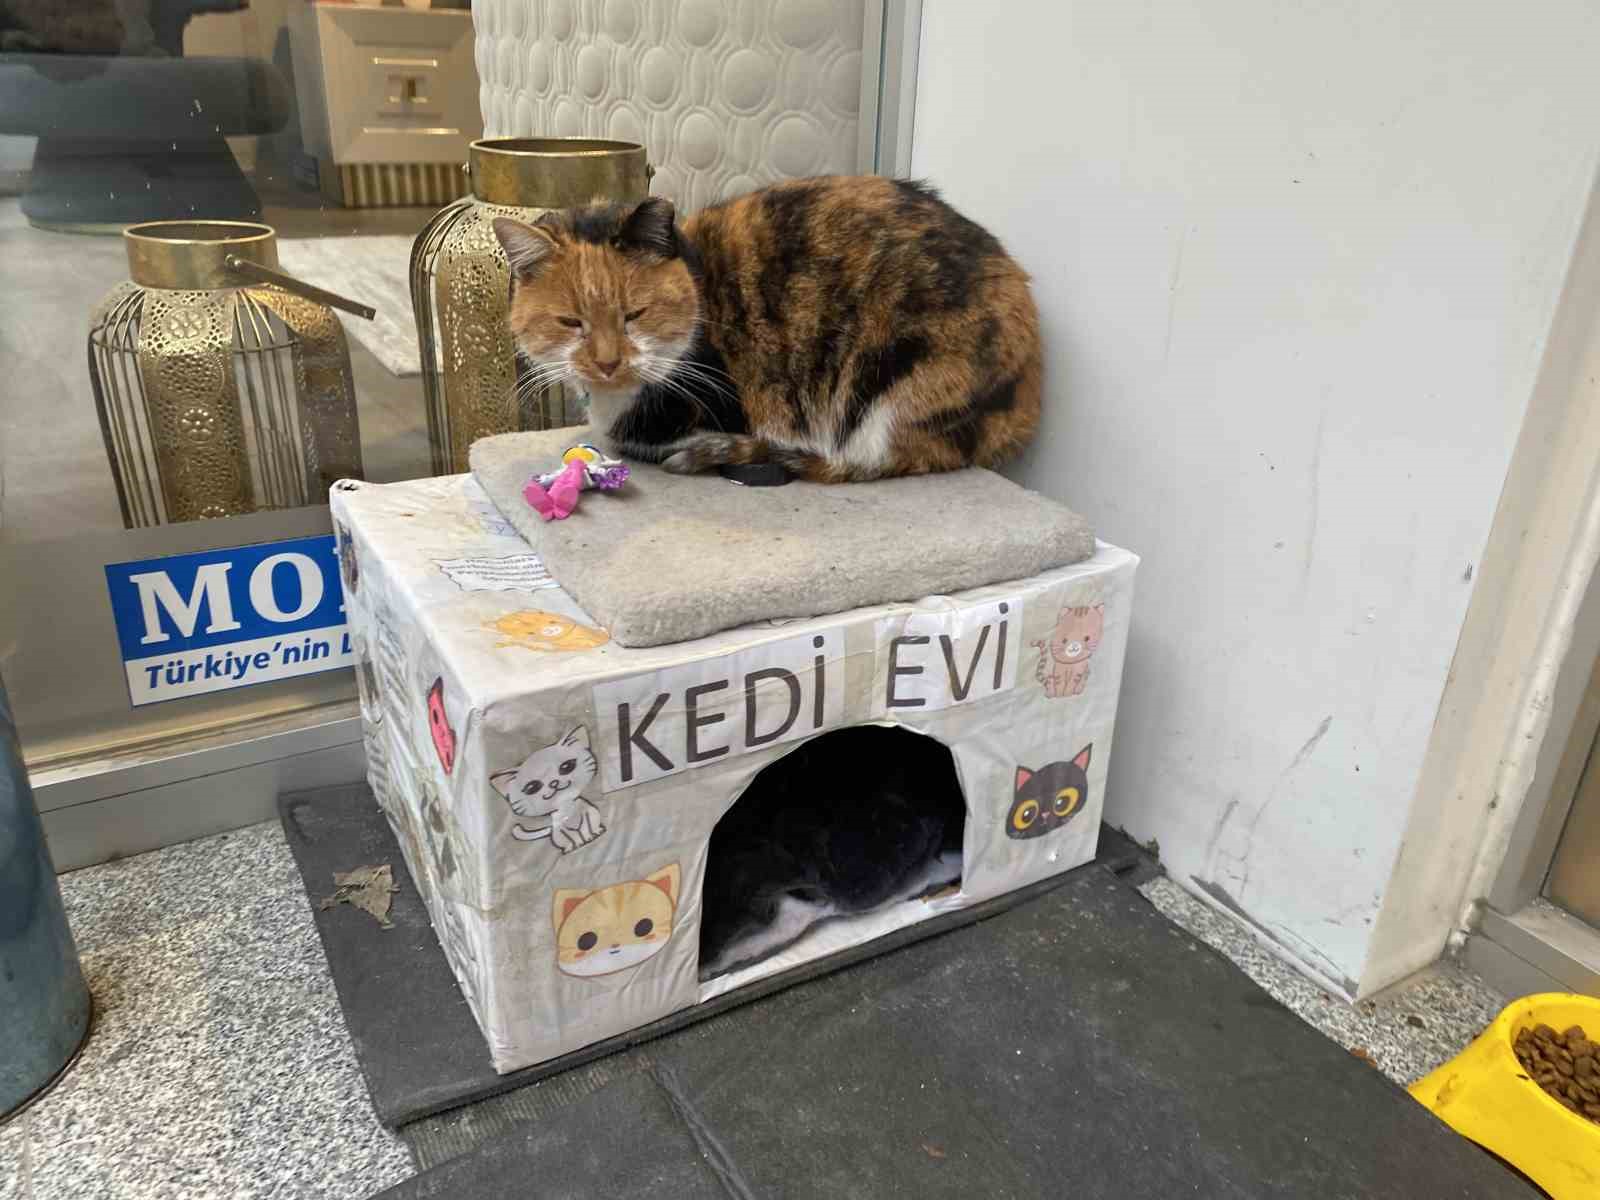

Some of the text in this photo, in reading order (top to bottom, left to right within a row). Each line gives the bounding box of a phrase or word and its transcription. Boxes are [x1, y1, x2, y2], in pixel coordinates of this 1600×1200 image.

[129, 547, 346, 644] MO
[145, 638, 330, 689] Türkiye'nin
[617, 602, 1008, 782] KEDİ EVİ
